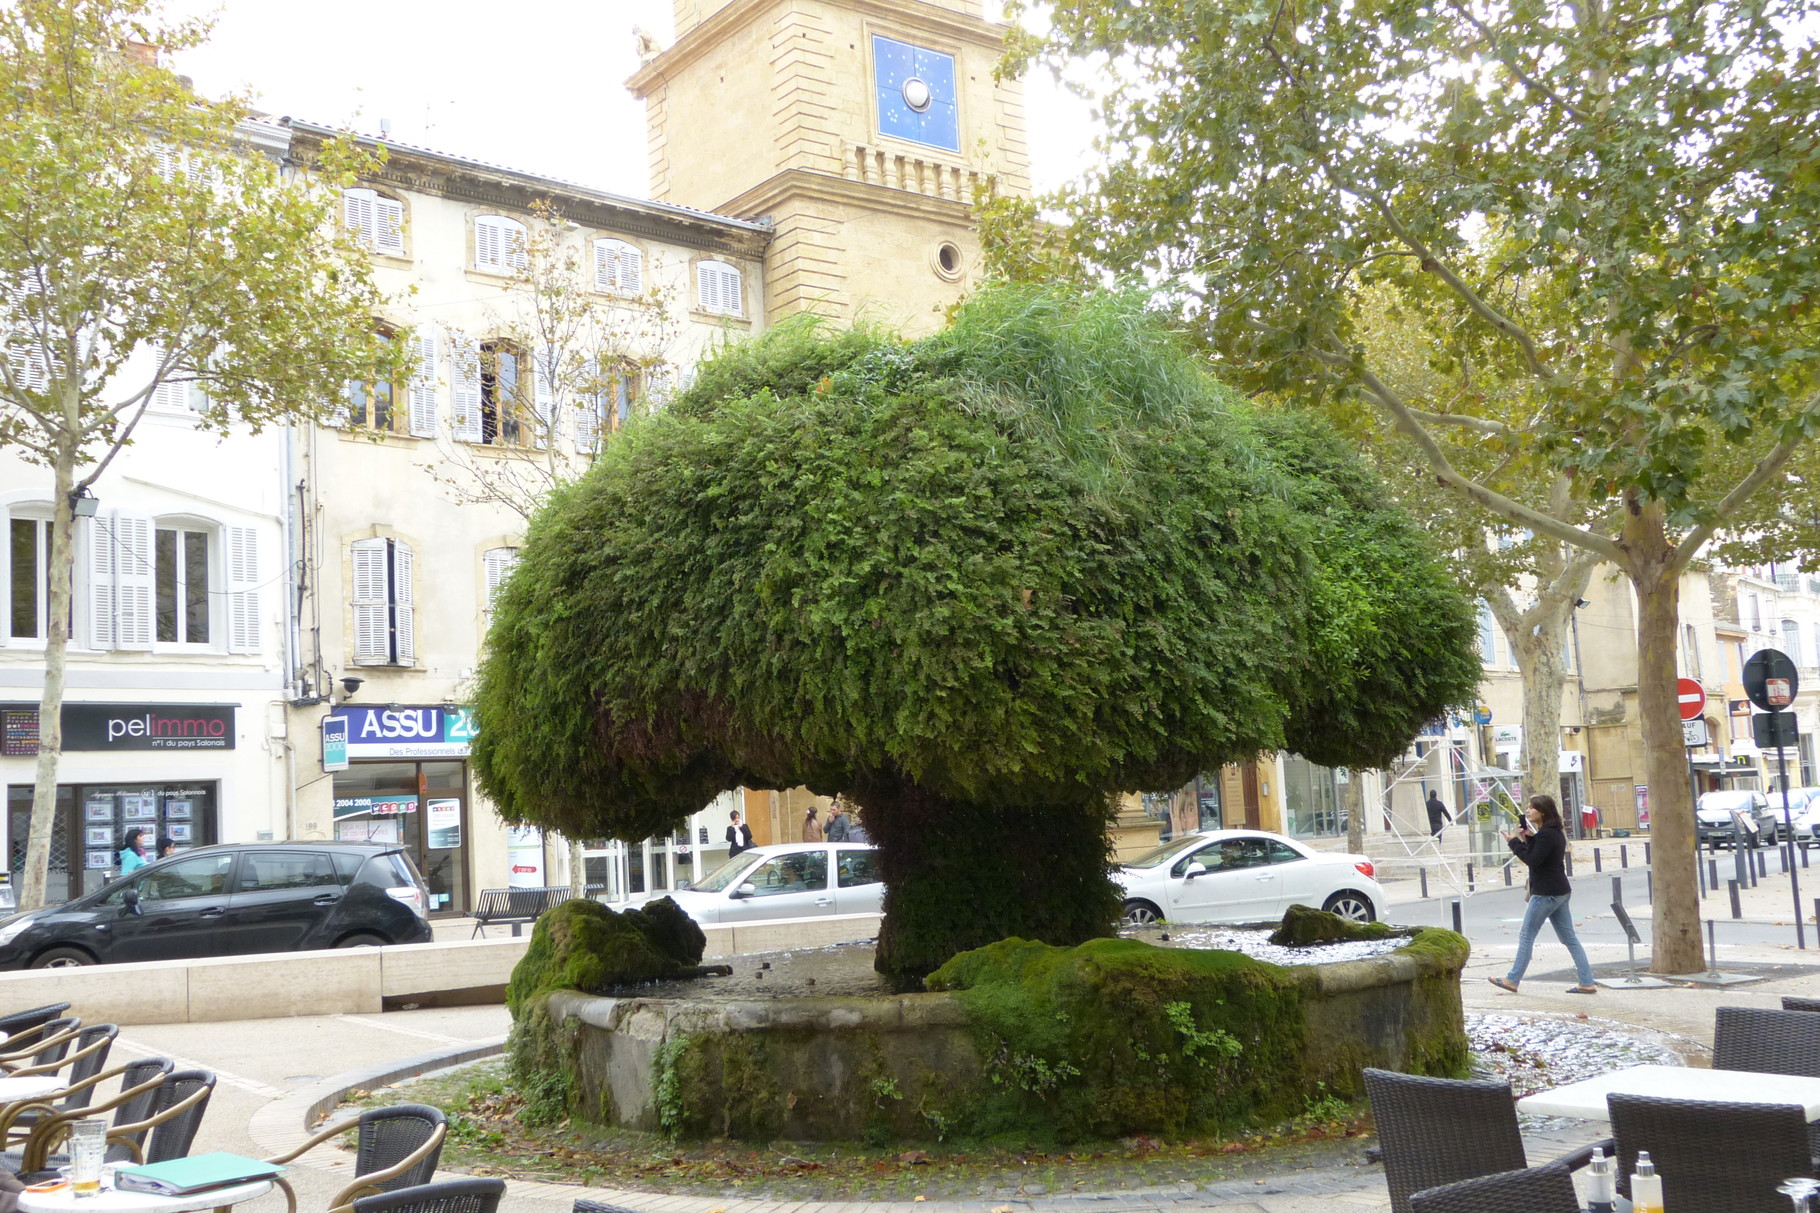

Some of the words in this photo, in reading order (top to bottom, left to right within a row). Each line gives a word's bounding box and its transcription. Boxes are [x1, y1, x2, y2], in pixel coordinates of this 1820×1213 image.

[108, 713, 225, 742] pelimmo
[360, 709, 438, 738] ASSU
[325, 732, 345, 742] ASSU
[389, 748, 404, 756] Des
[406, 747, 456, 756] Professionnels
